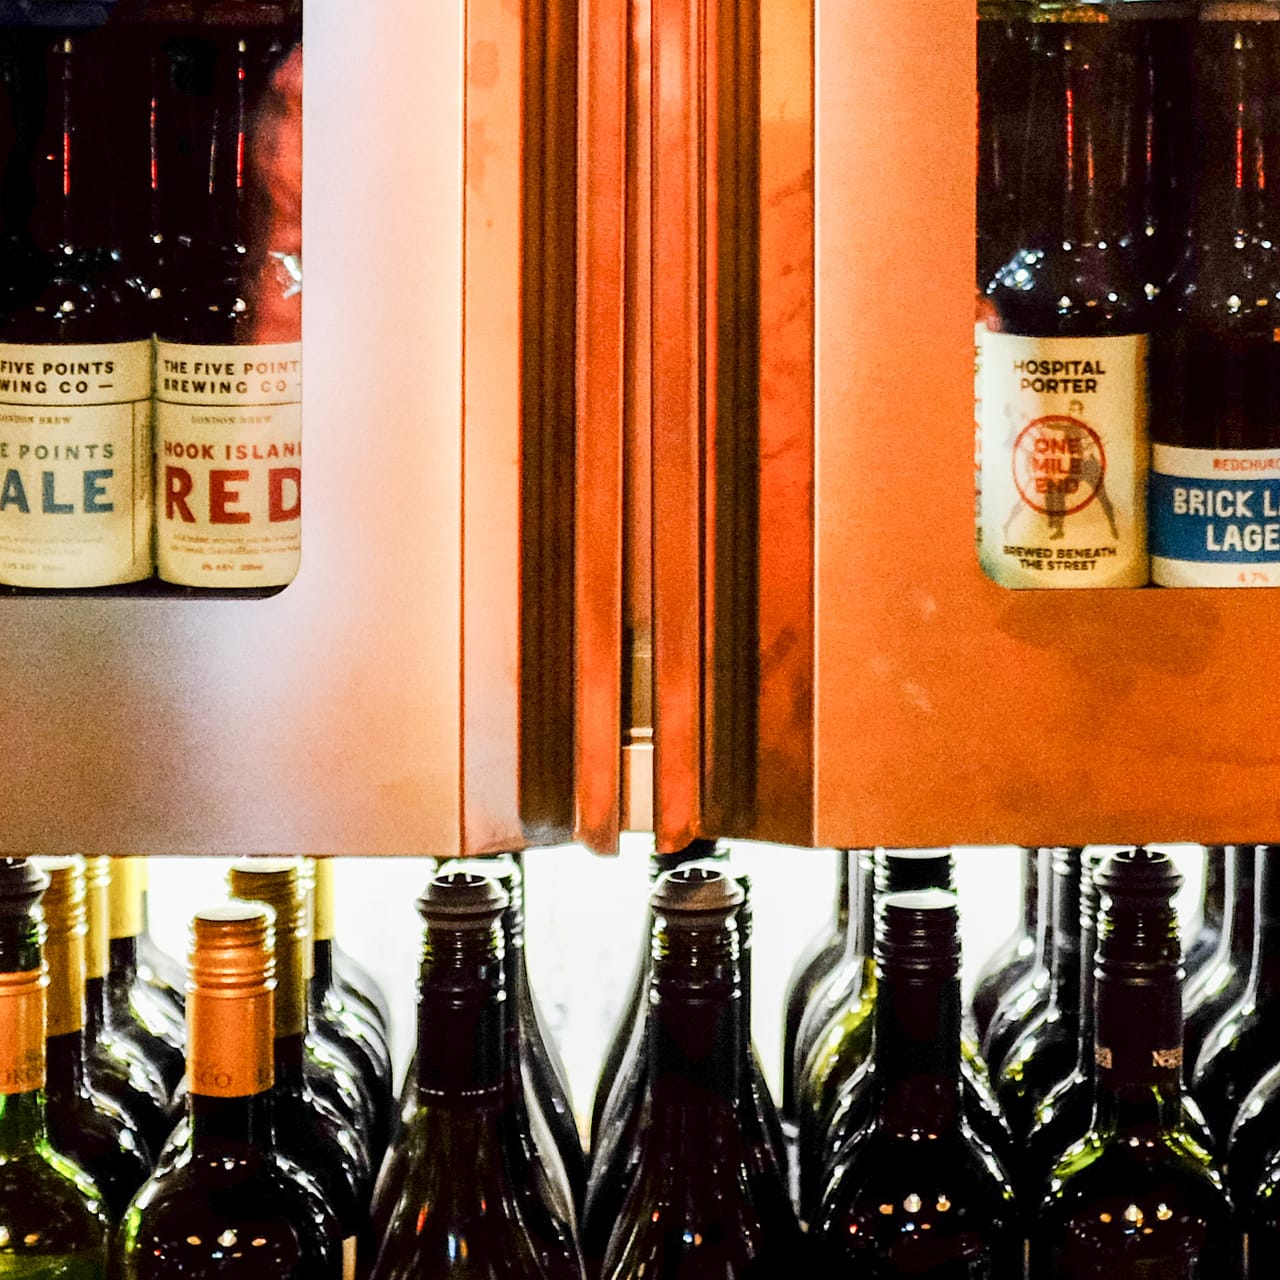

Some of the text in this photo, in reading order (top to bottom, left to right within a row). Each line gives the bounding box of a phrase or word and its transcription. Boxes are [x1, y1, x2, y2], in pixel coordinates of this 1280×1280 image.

[0, 360, 115, 376] FIVE POINTS
[164, 359, 301, 376] THE FIVE POINT
[1013, 360, 1107, 377] HOSPITAL
[58, 380, 88, 395] CO
[163, 378, 288, 395] BREWING CO
[1021, 378, 1100, 395] PORTER
[18, 443, 115, 461] POINTS
[164, 441, 302, 462] HOOK ISLAN
[1034, 437, 1082, 455] ONE
[1032, 457, 1083, 476] MILE
[1035, 477, 1081, 495] END
[165, 464, 302, 526] RED
[1173, 487, 1254, 518] BRICK
[1003, 545, 1117, 560] BREWED BENEATH
[1019, 558, 1098, 571] THE STREET
